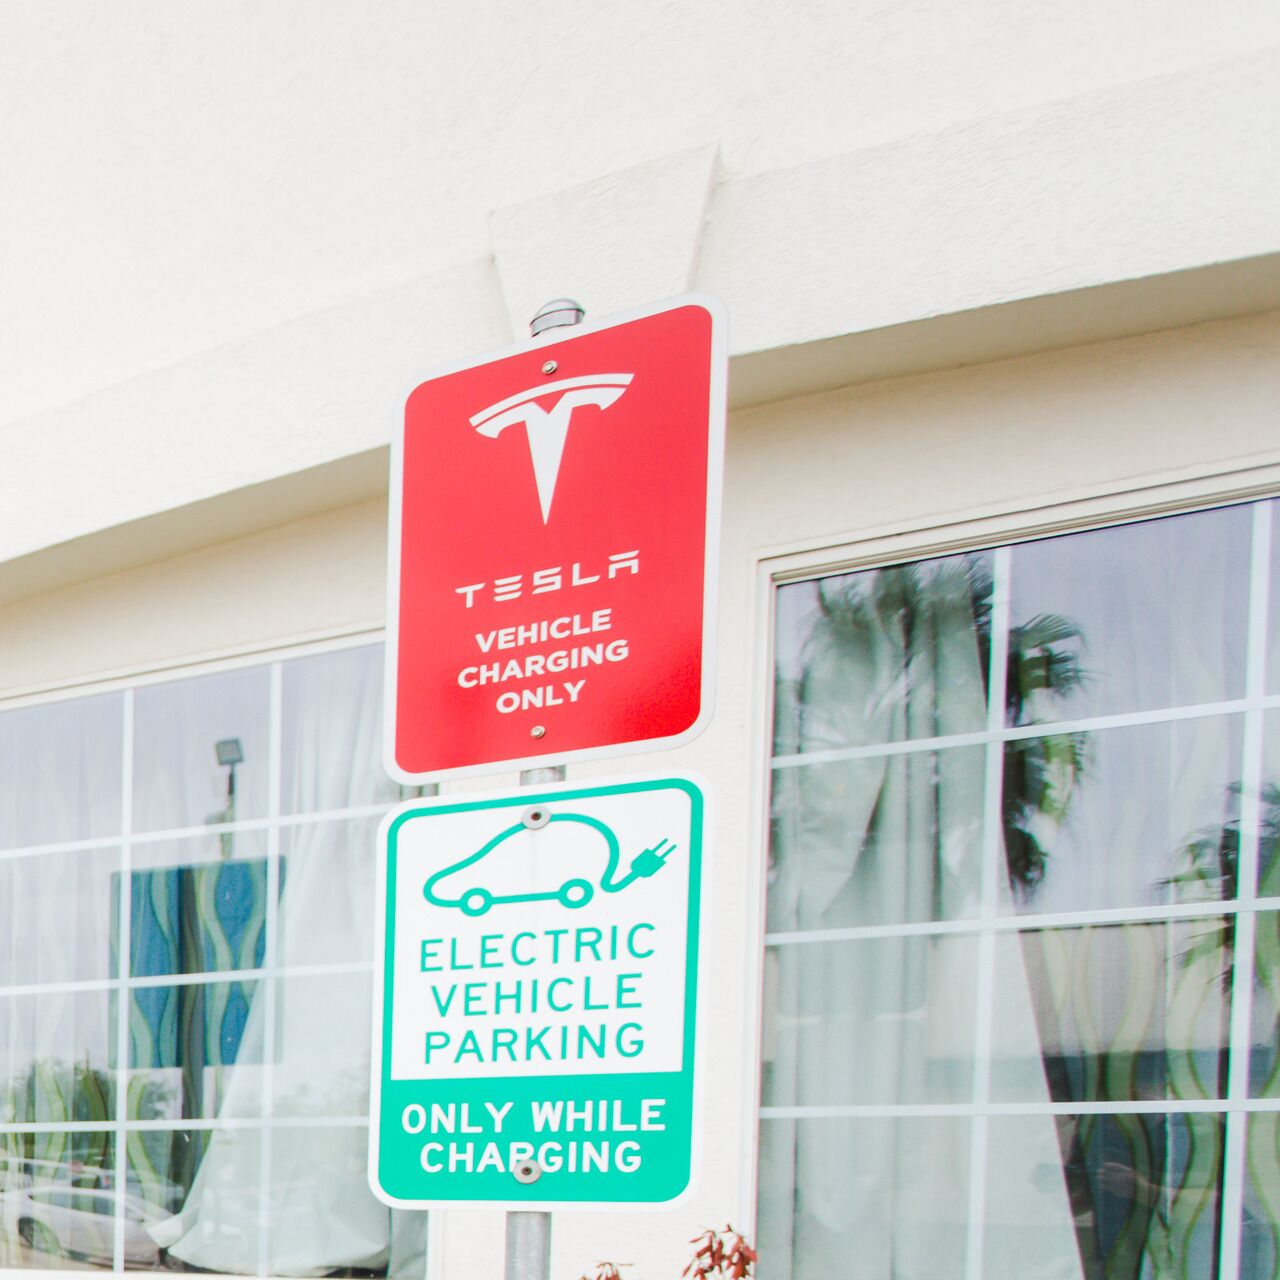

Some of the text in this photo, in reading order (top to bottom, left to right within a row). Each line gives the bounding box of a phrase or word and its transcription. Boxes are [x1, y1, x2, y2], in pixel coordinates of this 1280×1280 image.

[455, 549, 640, 608] TESLA
[474, 608, 612, 653] VEHICLE
[457, 639, 629, 689] CHARGING
[495, 680, 586, 714] ONLY
[420, 923, 656, 972] ELECTRIC
[431, 973, 643, 1017] VEHICLE
[424, 1022, 645, 1064] PARKING
[401, 1099, 666, 1134] ONLY WHILE
[420, 1141, 642, 1173] CHARGING
